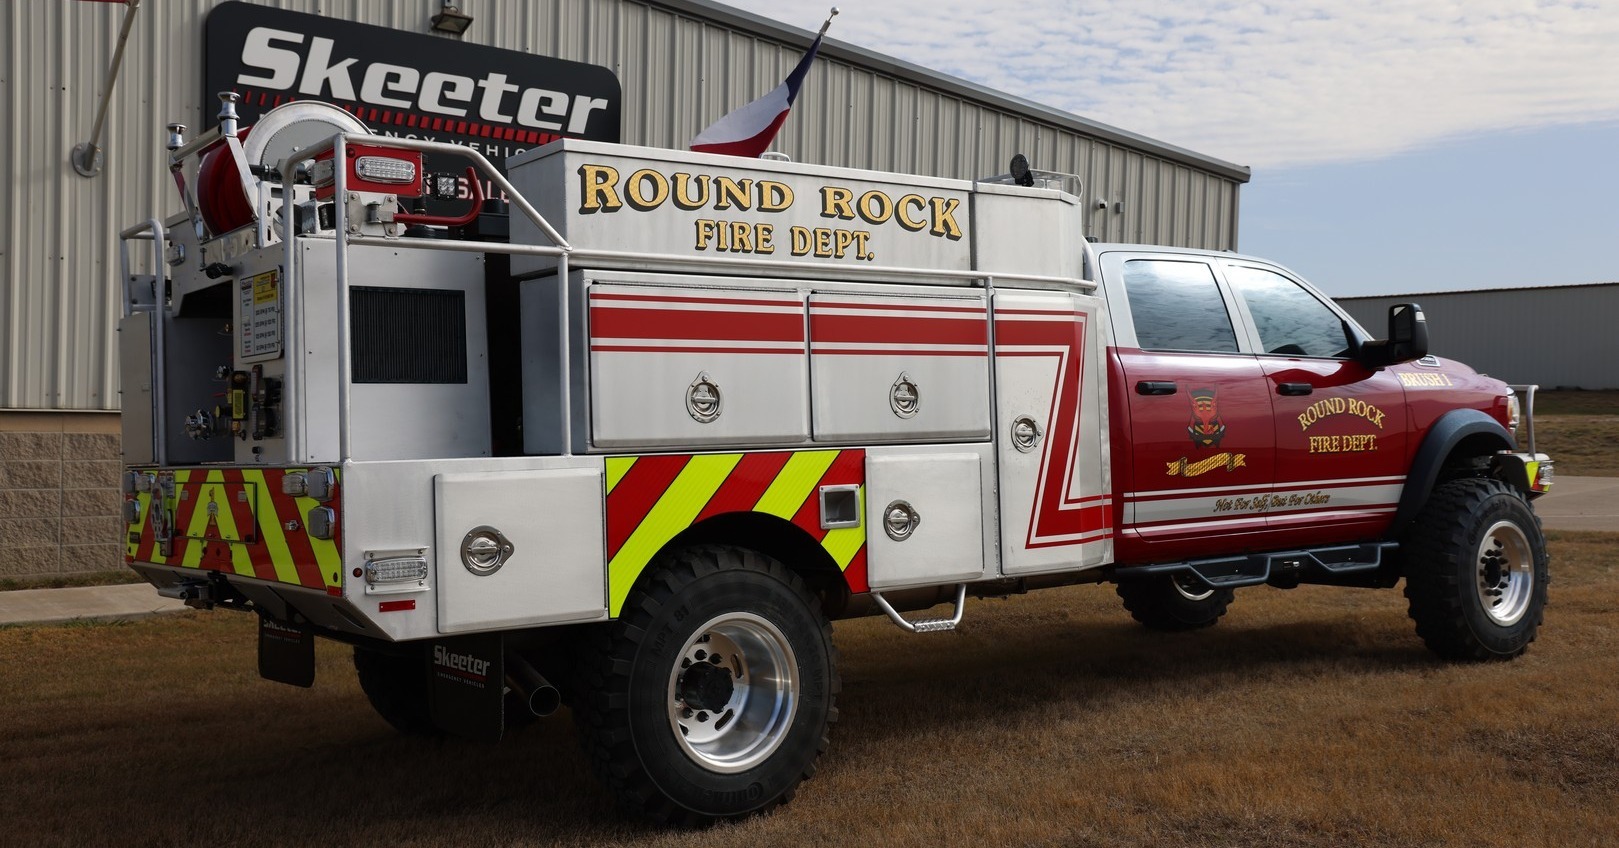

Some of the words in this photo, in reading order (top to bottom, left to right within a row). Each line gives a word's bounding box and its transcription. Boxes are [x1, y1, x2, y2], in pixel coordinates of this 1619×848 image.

[236, 27, 608, 134] Skeeter
[578, 163, 795, 214] ROUND
[819, 186, 962, 241] ROCK
[695, 219, 775, 254] FIRE
[790, 226, 875, 261] DEPT.
[1398, 372, 1446, 387] BRUSH
[1441, 373, 1454, 387] 1
[1297, 397, 1346, 431] ROUND
[1347, 397, 1386, 429] ROCK
[1309, 435, 1341, 454] FIRE
[1342, 434, 1379, 452] DEPT.
[1213, 498, 1233, 512] Not
[434, 644, 491, 677] Skeeter
